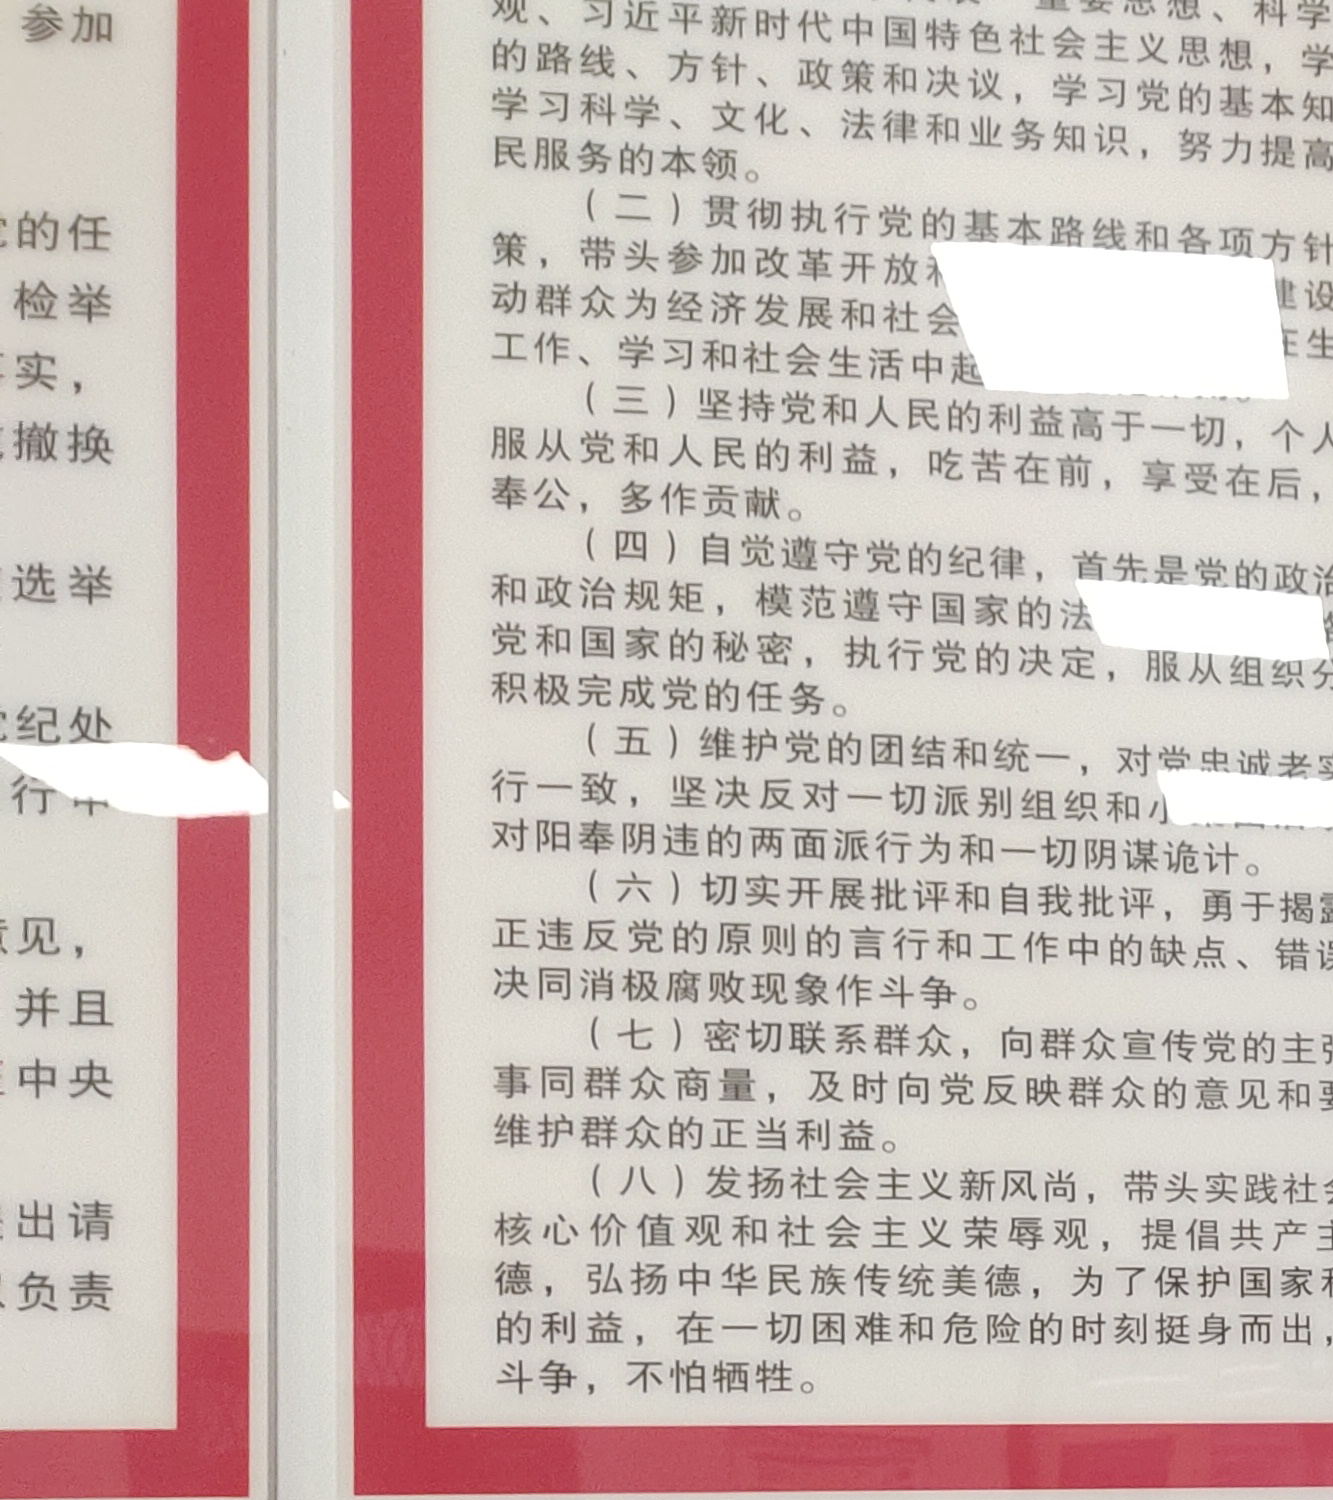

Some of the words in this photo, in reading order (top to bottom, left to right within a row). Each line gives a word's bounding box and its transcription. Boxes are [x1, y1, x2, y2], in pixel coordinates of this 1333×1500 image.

[22, 4, 113, 43] 参加
[495, 137, 766, 182] 民服务的本领。
[0, 212, 111, 252] 的任
[15, 280, 112, 322] 检举
[0, 422, 114, 466] 撤换
[492, 476, 805, 522] 奉公，多作贡献。
[492, 672, 848, 718] 积极完成党的任务。
[0, 705, 112, 743] 纪处
[493, 818, 1262, 874] 对阳奉阴违的两面派行为和一切阴谋诡计。
[16, 987, 114, 1029] 并且
[494, 966, 980, 1009] 决同消极腐败现象作斗争。
[0, 1058, 114, 1099] 中央
[495, 1114, 899, 1154] 维护群众的正当利益。
[0, 1200, 114, 1243] 出请
[497, 1360, 816, 1394] 斗争，不怕牺牲。
